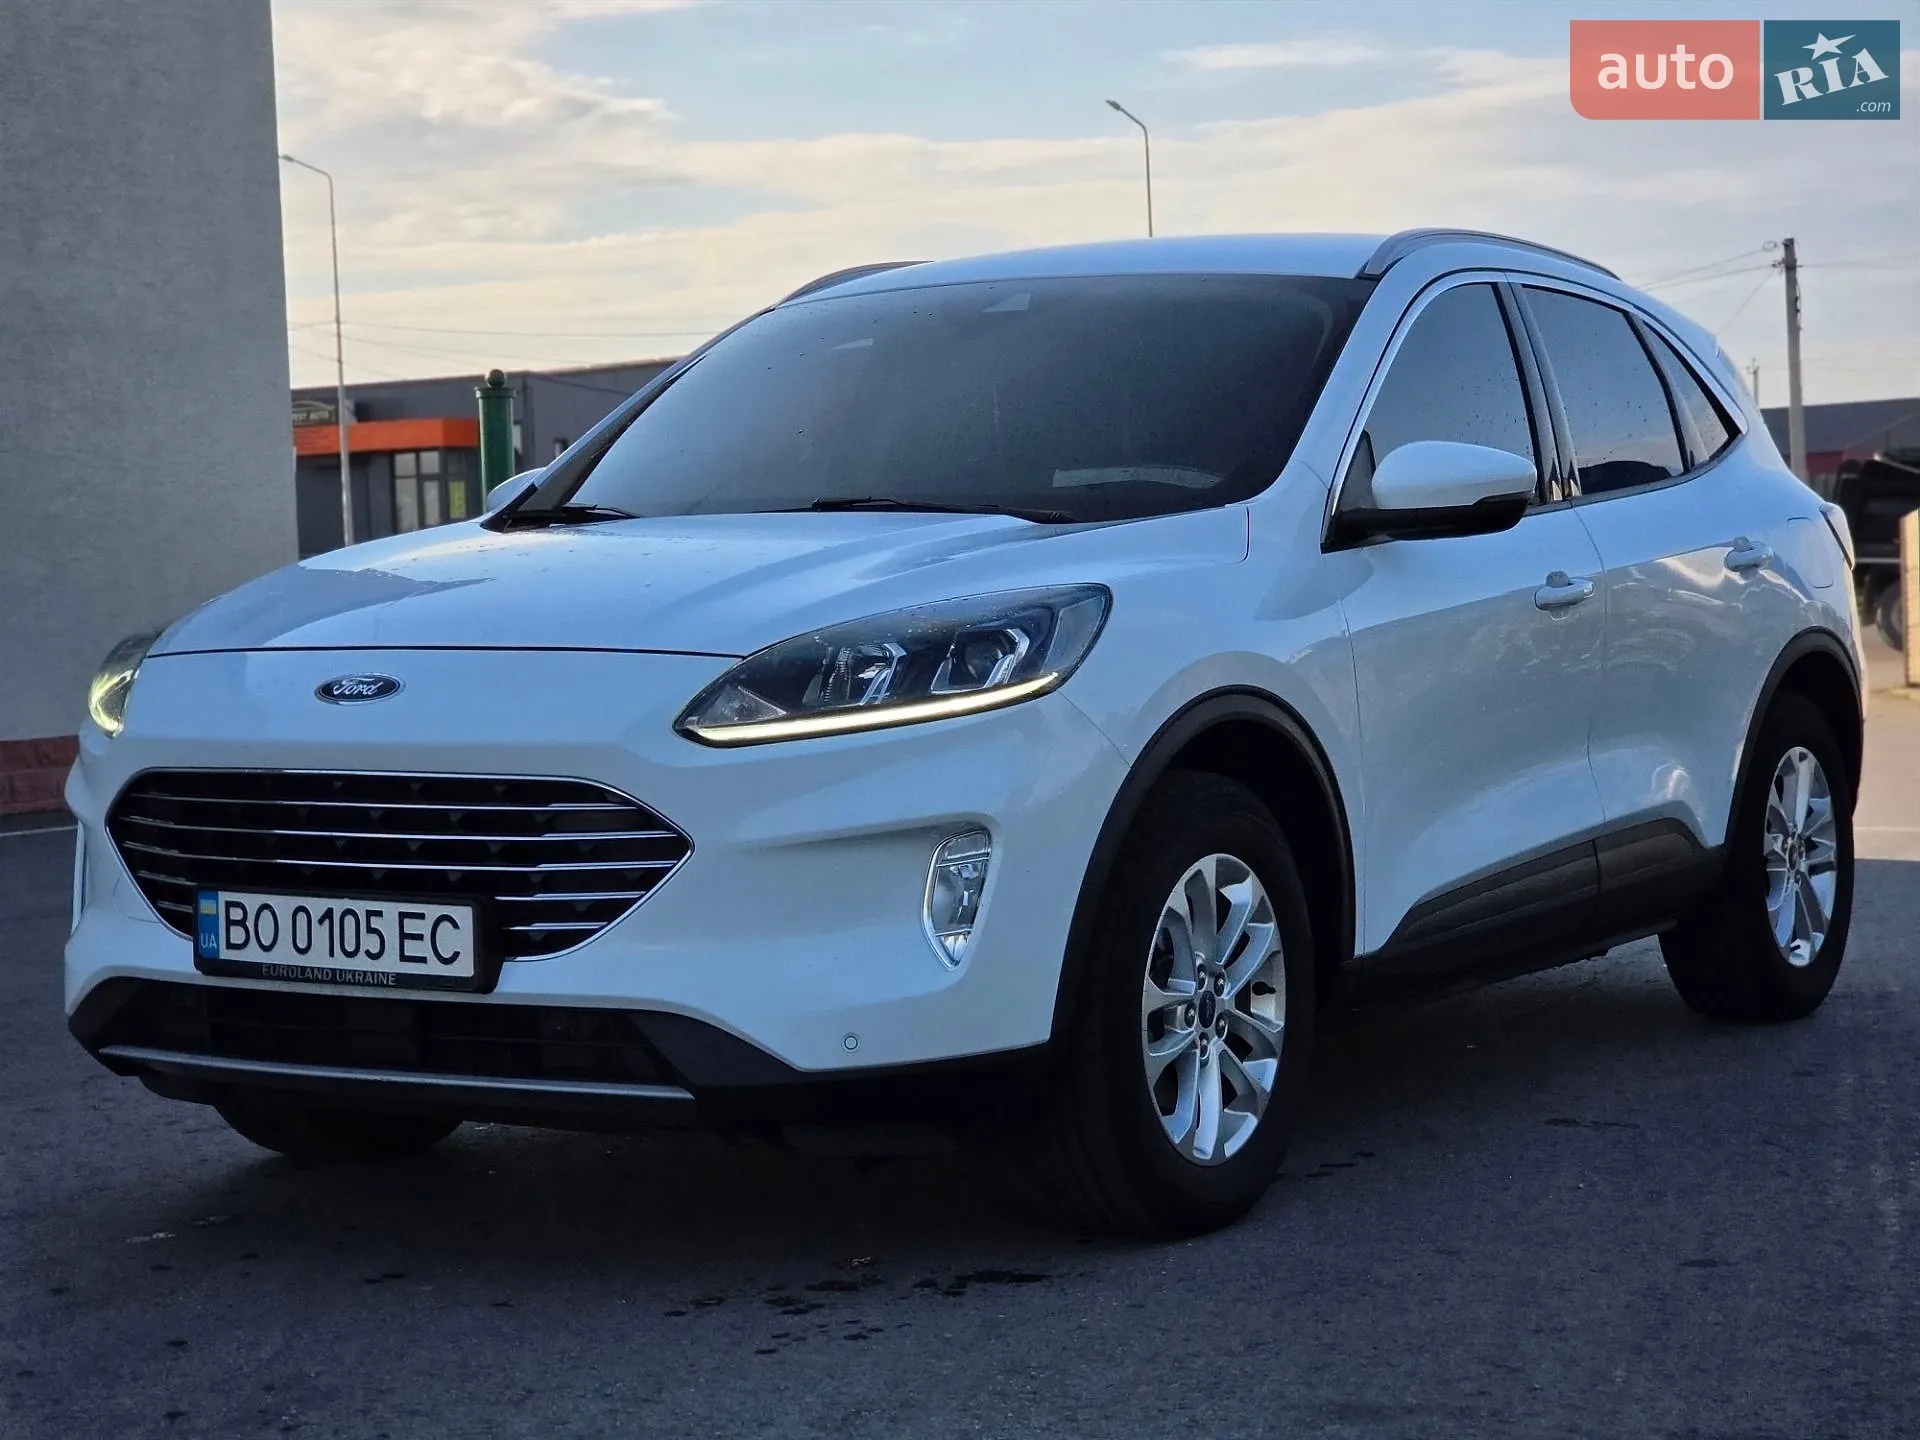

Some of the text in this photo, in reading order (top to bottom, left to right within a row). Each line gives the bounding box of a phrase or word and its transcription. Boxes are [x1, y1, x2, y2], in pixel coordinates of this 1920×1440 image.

[332, 678, 384, 696] Ford
[200, 933, 218, 949] UA
[224, 900, 461, 966] BO 0105 EC
[261, 964, 397, 986] EUROLAND UKRAINE
